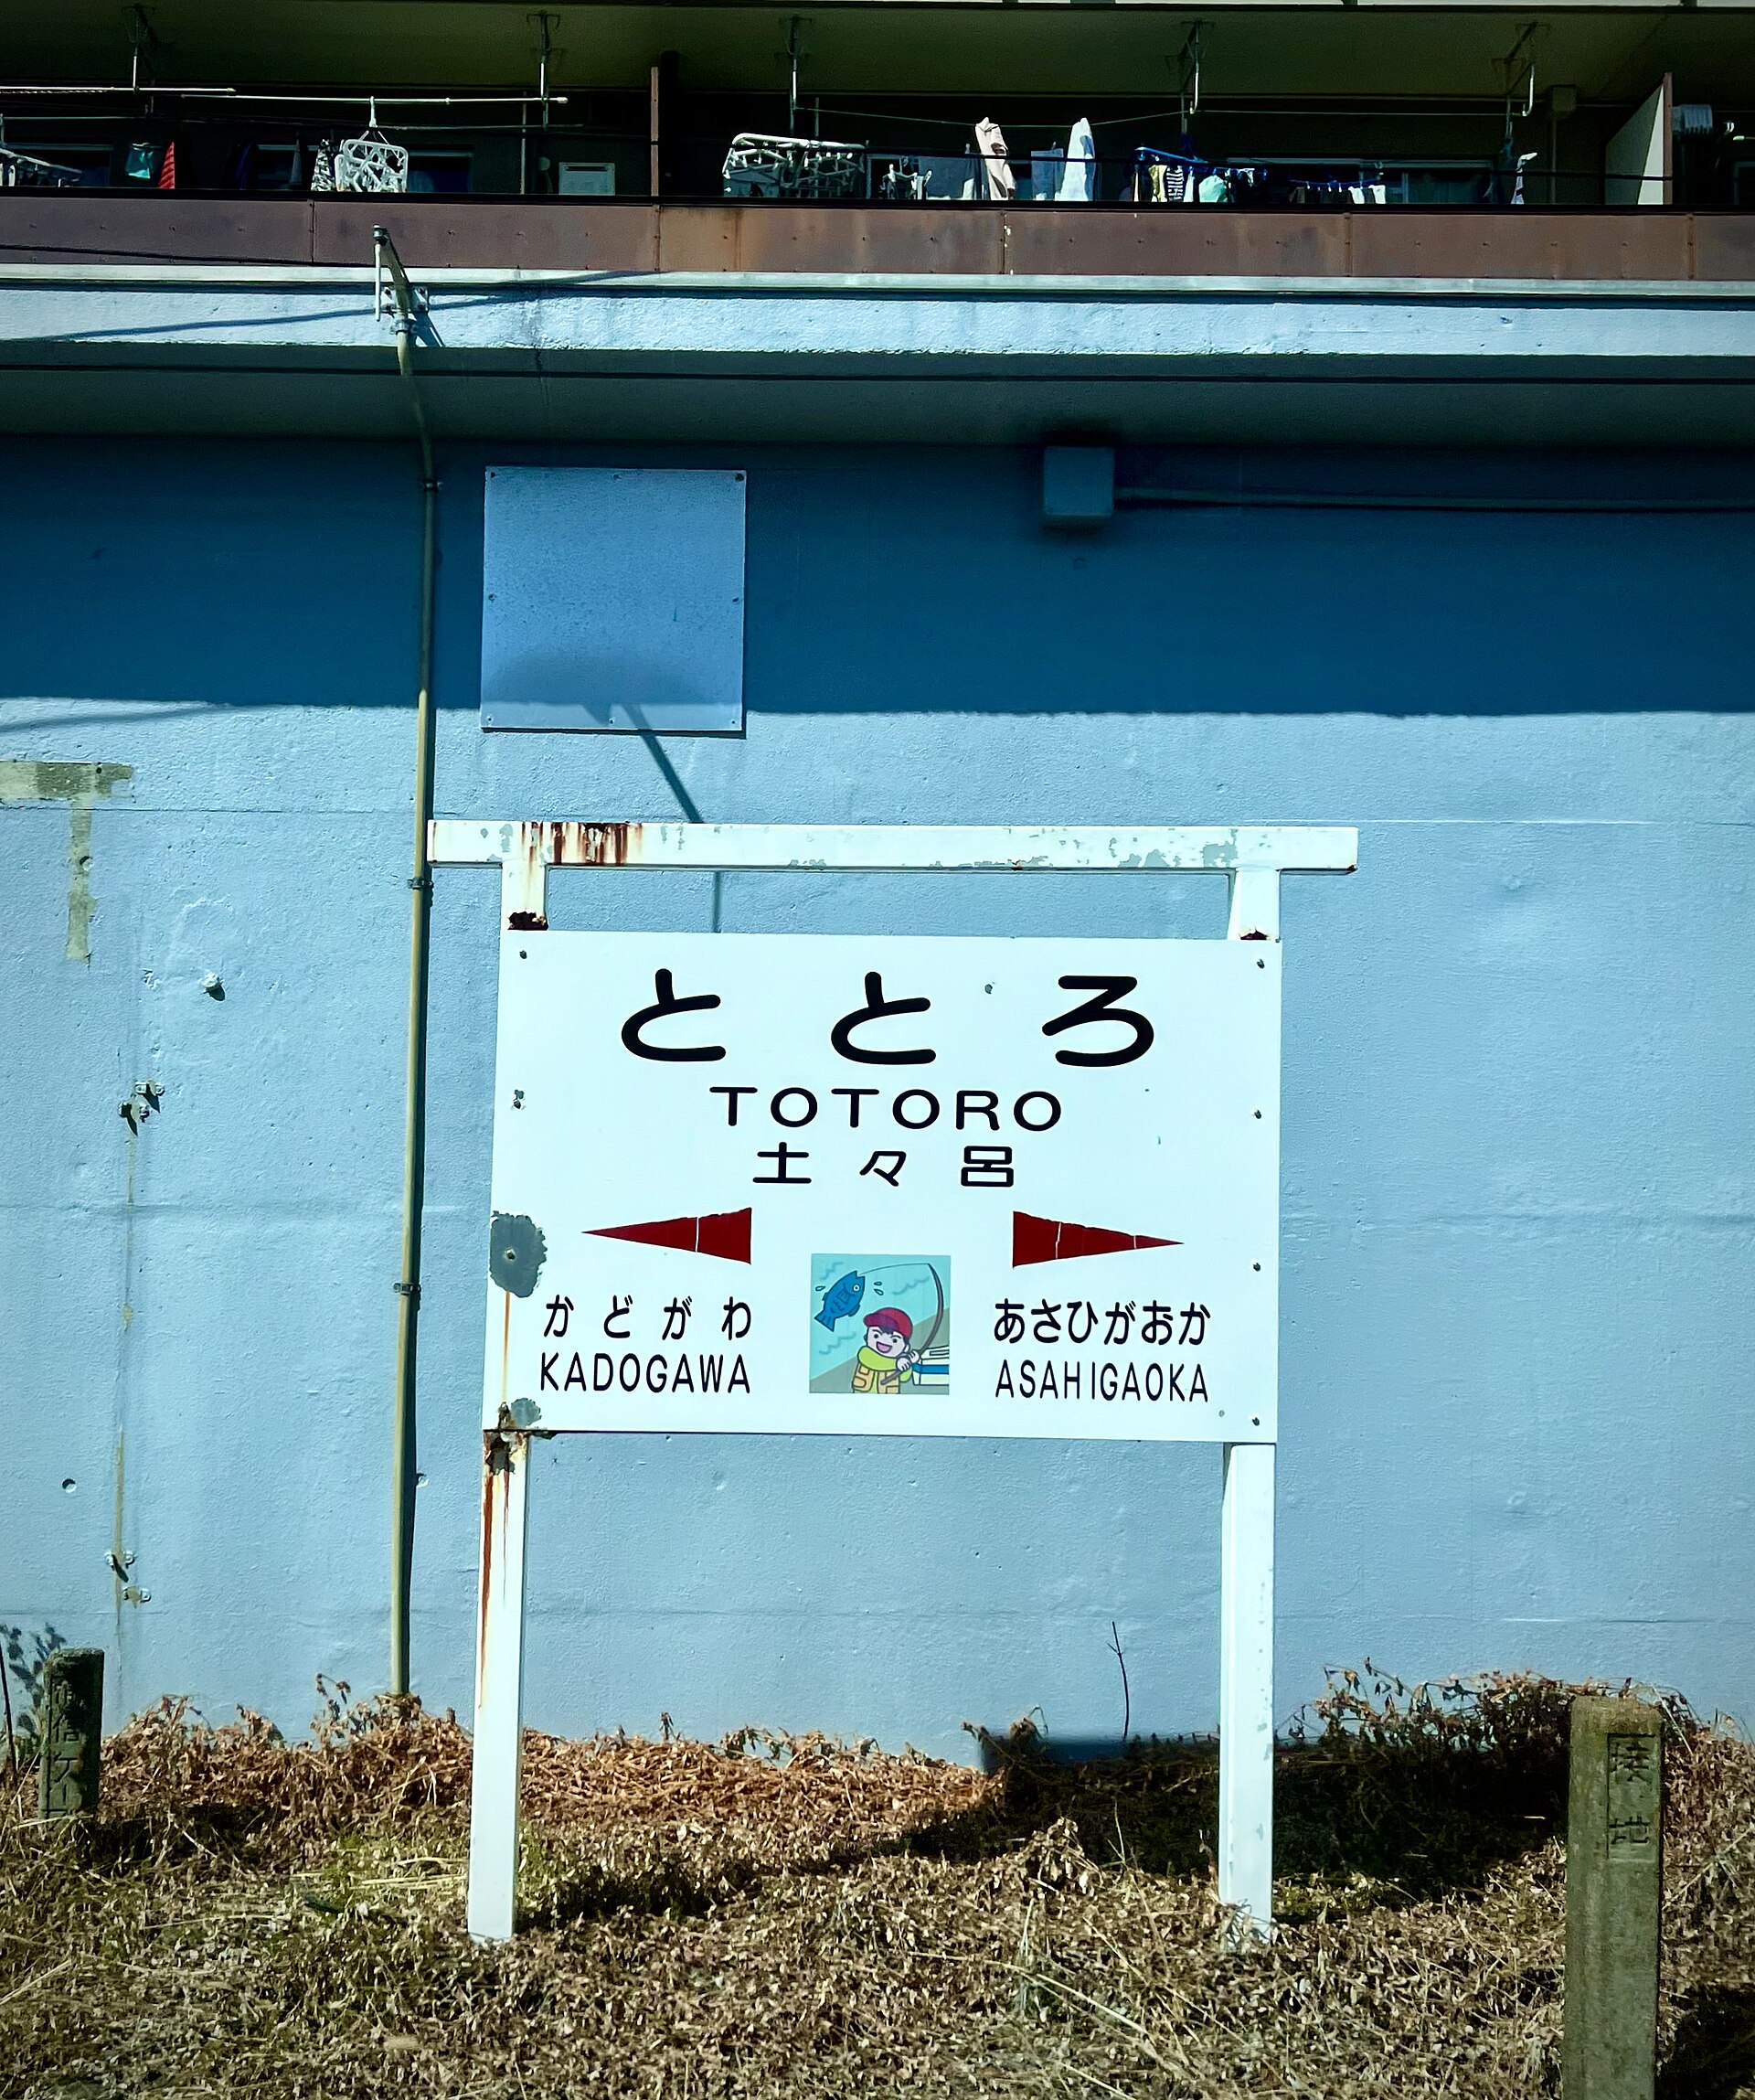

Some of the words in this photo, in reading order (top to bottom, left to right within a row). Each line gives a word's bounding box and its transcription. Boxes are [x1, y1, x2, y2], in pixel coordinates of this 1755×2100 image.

[622, 969, 1154, 1068] ととろ
[710, 1086, 1062, 1132] TOTORO
[753, 1142, 1015, 1188] 土々呂
[544, 1294, 751, 1341] かどがわ
[994, 1298, 1211, 1346] あさひがおか
[541, 1352, 750, 1394] KADOGAWA
[995, 1359, 1208, 1402] ASAHIGAOKA
